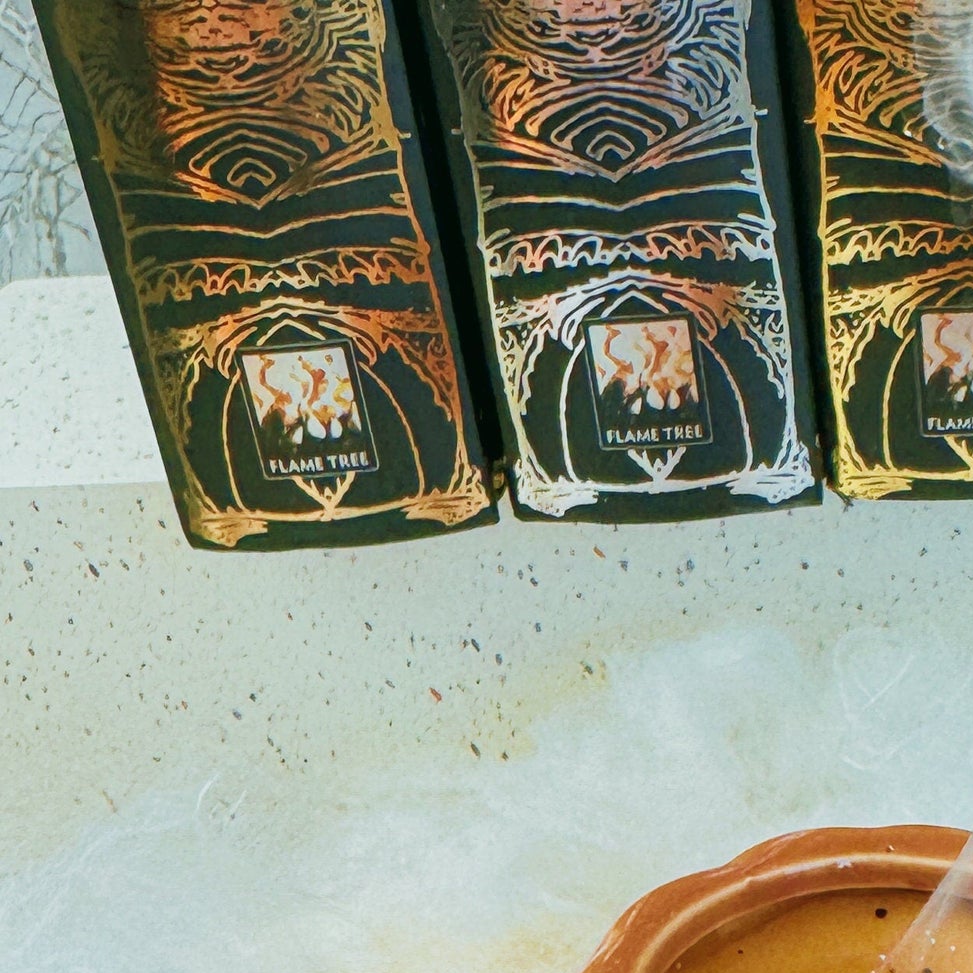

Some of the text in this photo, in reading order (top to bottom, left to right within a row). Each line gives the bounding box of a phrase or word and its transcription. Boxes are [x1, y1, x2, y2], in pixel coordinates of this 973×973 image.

[606, 424, 703, 443] FLAME TREE
[269, 451, 369, 473] FLAME TREE
